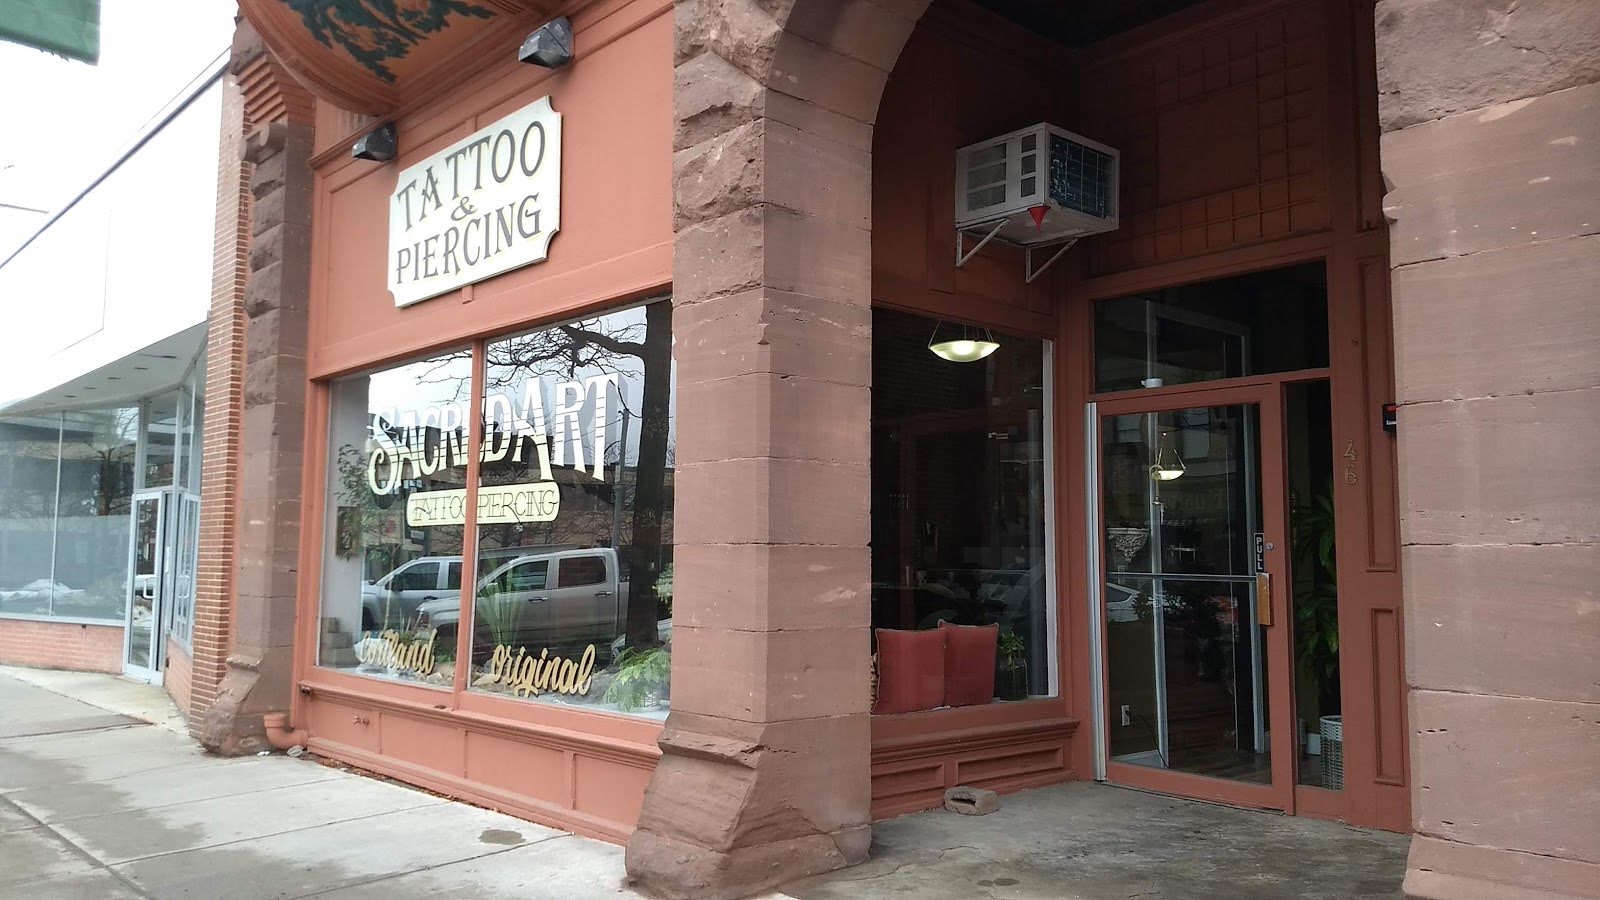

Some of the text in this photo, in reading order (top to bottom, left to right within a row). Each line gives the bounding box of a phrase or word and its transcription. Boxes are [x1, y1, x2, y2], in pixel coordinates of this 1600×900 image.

[397, 120, 546, 232] TATTOO
[396, 192, 542, 284] PIERCING
[450, 196, 478, 221] &
[511, 372, 620, 482] ART
[477, 489, 559, 523] PIERCING
[1255, 537, 1263, 571] PULL
